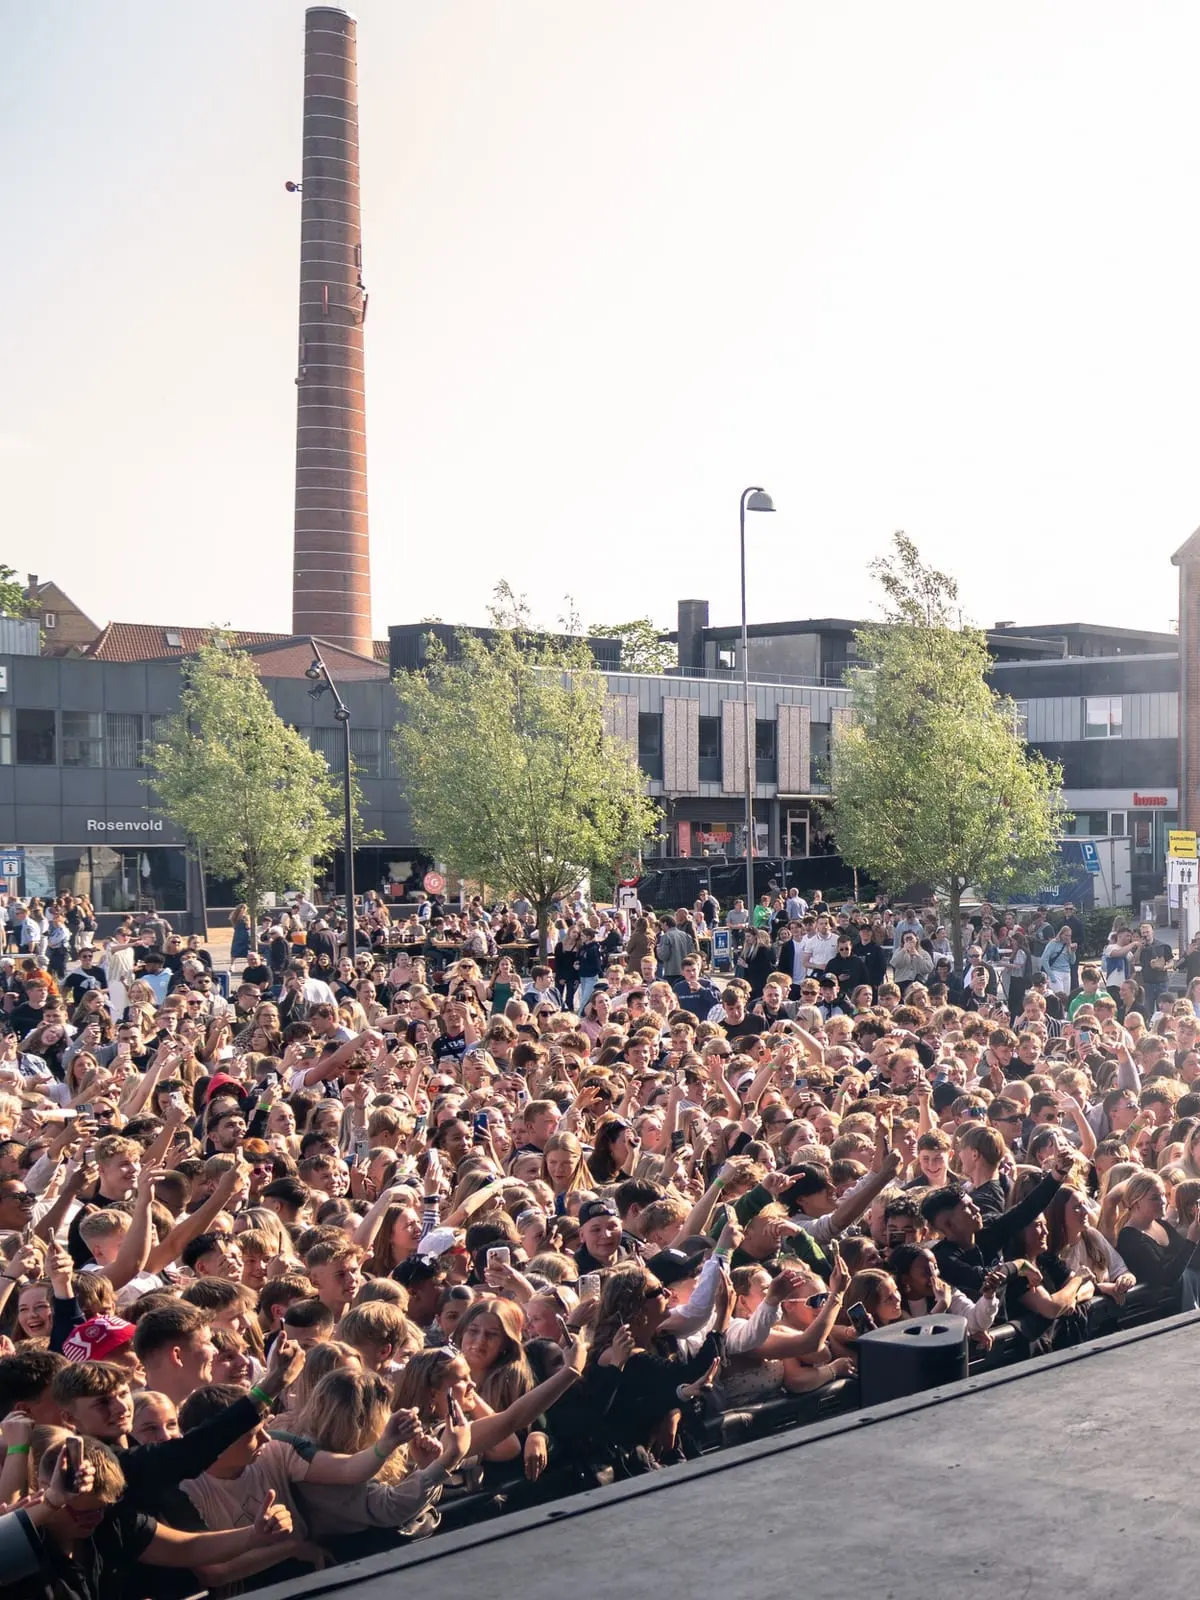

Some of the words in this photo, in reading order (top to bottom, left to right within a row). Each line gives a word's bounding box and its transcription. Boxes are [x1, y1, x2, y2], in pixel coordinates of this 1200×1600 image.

[1133, 792, 1168, 806] home
[87, 819, 163, 831] Rosenvold
[1084, 845, 1094, 859] P
